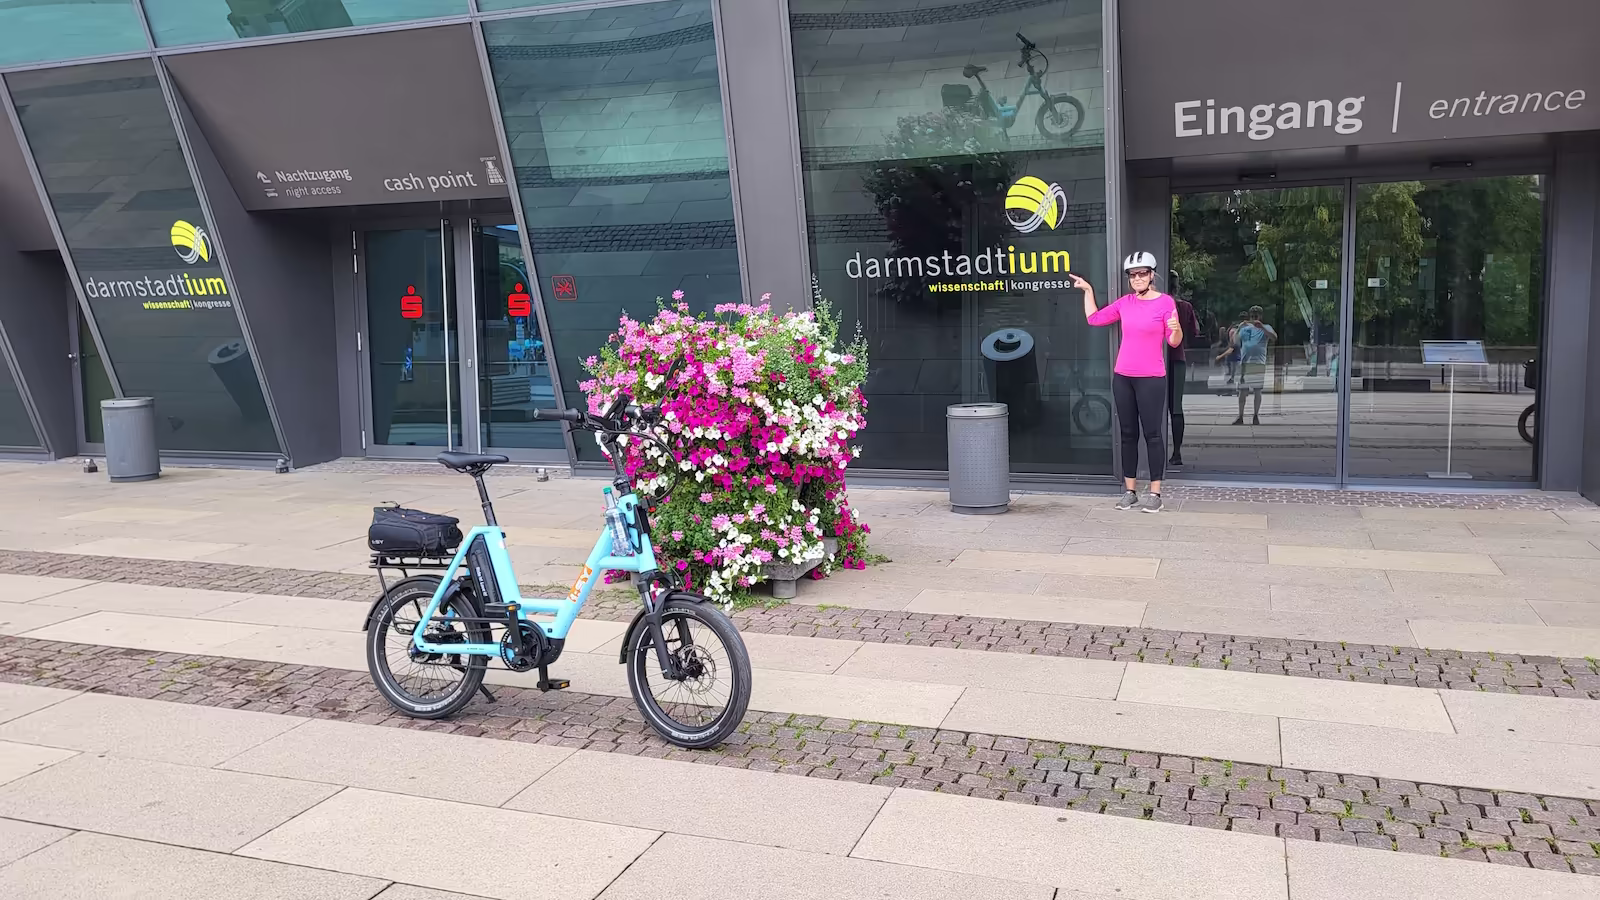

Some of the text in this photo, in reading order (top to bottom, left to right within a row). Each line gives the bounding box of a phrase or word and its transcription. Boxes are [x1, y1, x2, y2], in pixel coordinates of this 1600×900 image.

[1174, 88, 1586, 140] Eingang entrance
[275, 168, 352, 183] Nachtzugang
[384, 171, 477, 192] cash point
[285, 185, 341, 198] night access
[845, 245, 1070, 278] darmstadtium
[86, 273, 227, 298] darmstadtium
[928, 279, 1070, 292] wissenschaft kongresse
[143, 299, 231, 310] wissenschaft kongresse
